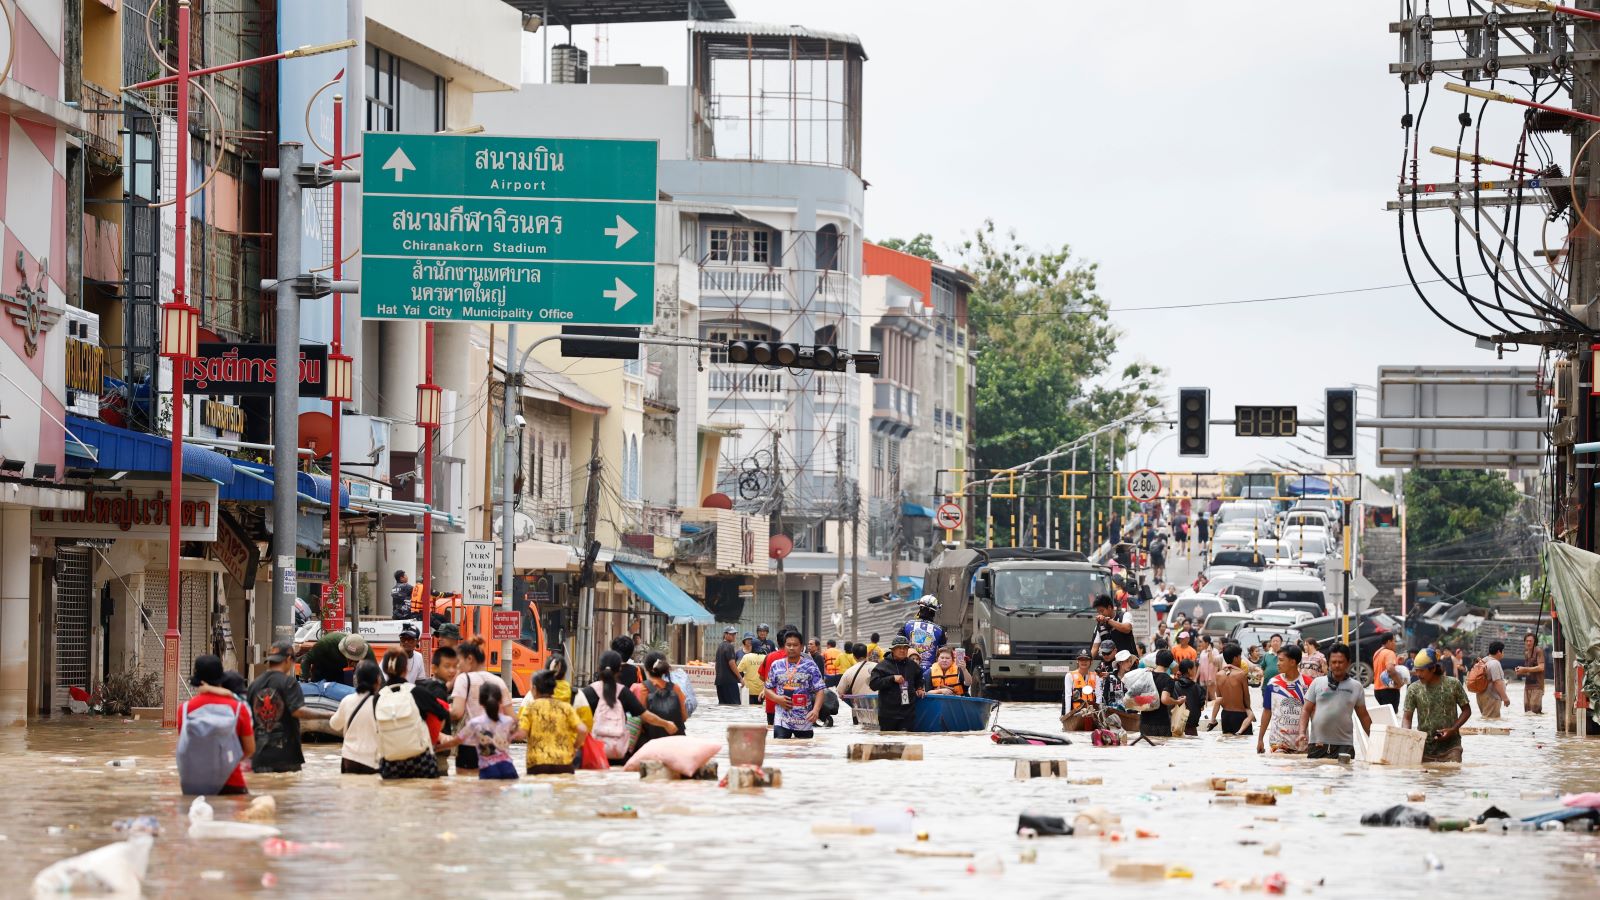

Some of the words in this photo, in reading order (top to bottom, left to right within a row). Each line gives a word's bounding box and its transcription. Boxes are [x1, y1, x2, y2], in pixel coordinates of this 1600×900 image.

[475, 145, 565, 173] สนามบิน
[490, 179, 546, 192] Airport
[392, 205, 563, 235] สนามกีฬาจิรนคร
[402, 240, 484, 252] Chiranakorn
[493, 242, 547, 254] Stadium
[412, 259, 541, 283] สำนักงานเทศบาล
[411, 282, 507, 307] นครหาดใหญ่
[377, 303, 397, 316] Hat
[403, 304, 420, 316] Yai
[428, 305, 453, 318] City
[462, 307, 533, 320] Municipality
[539, 308, 574, 320] Office
[469, 552, 490, 560] TURN
